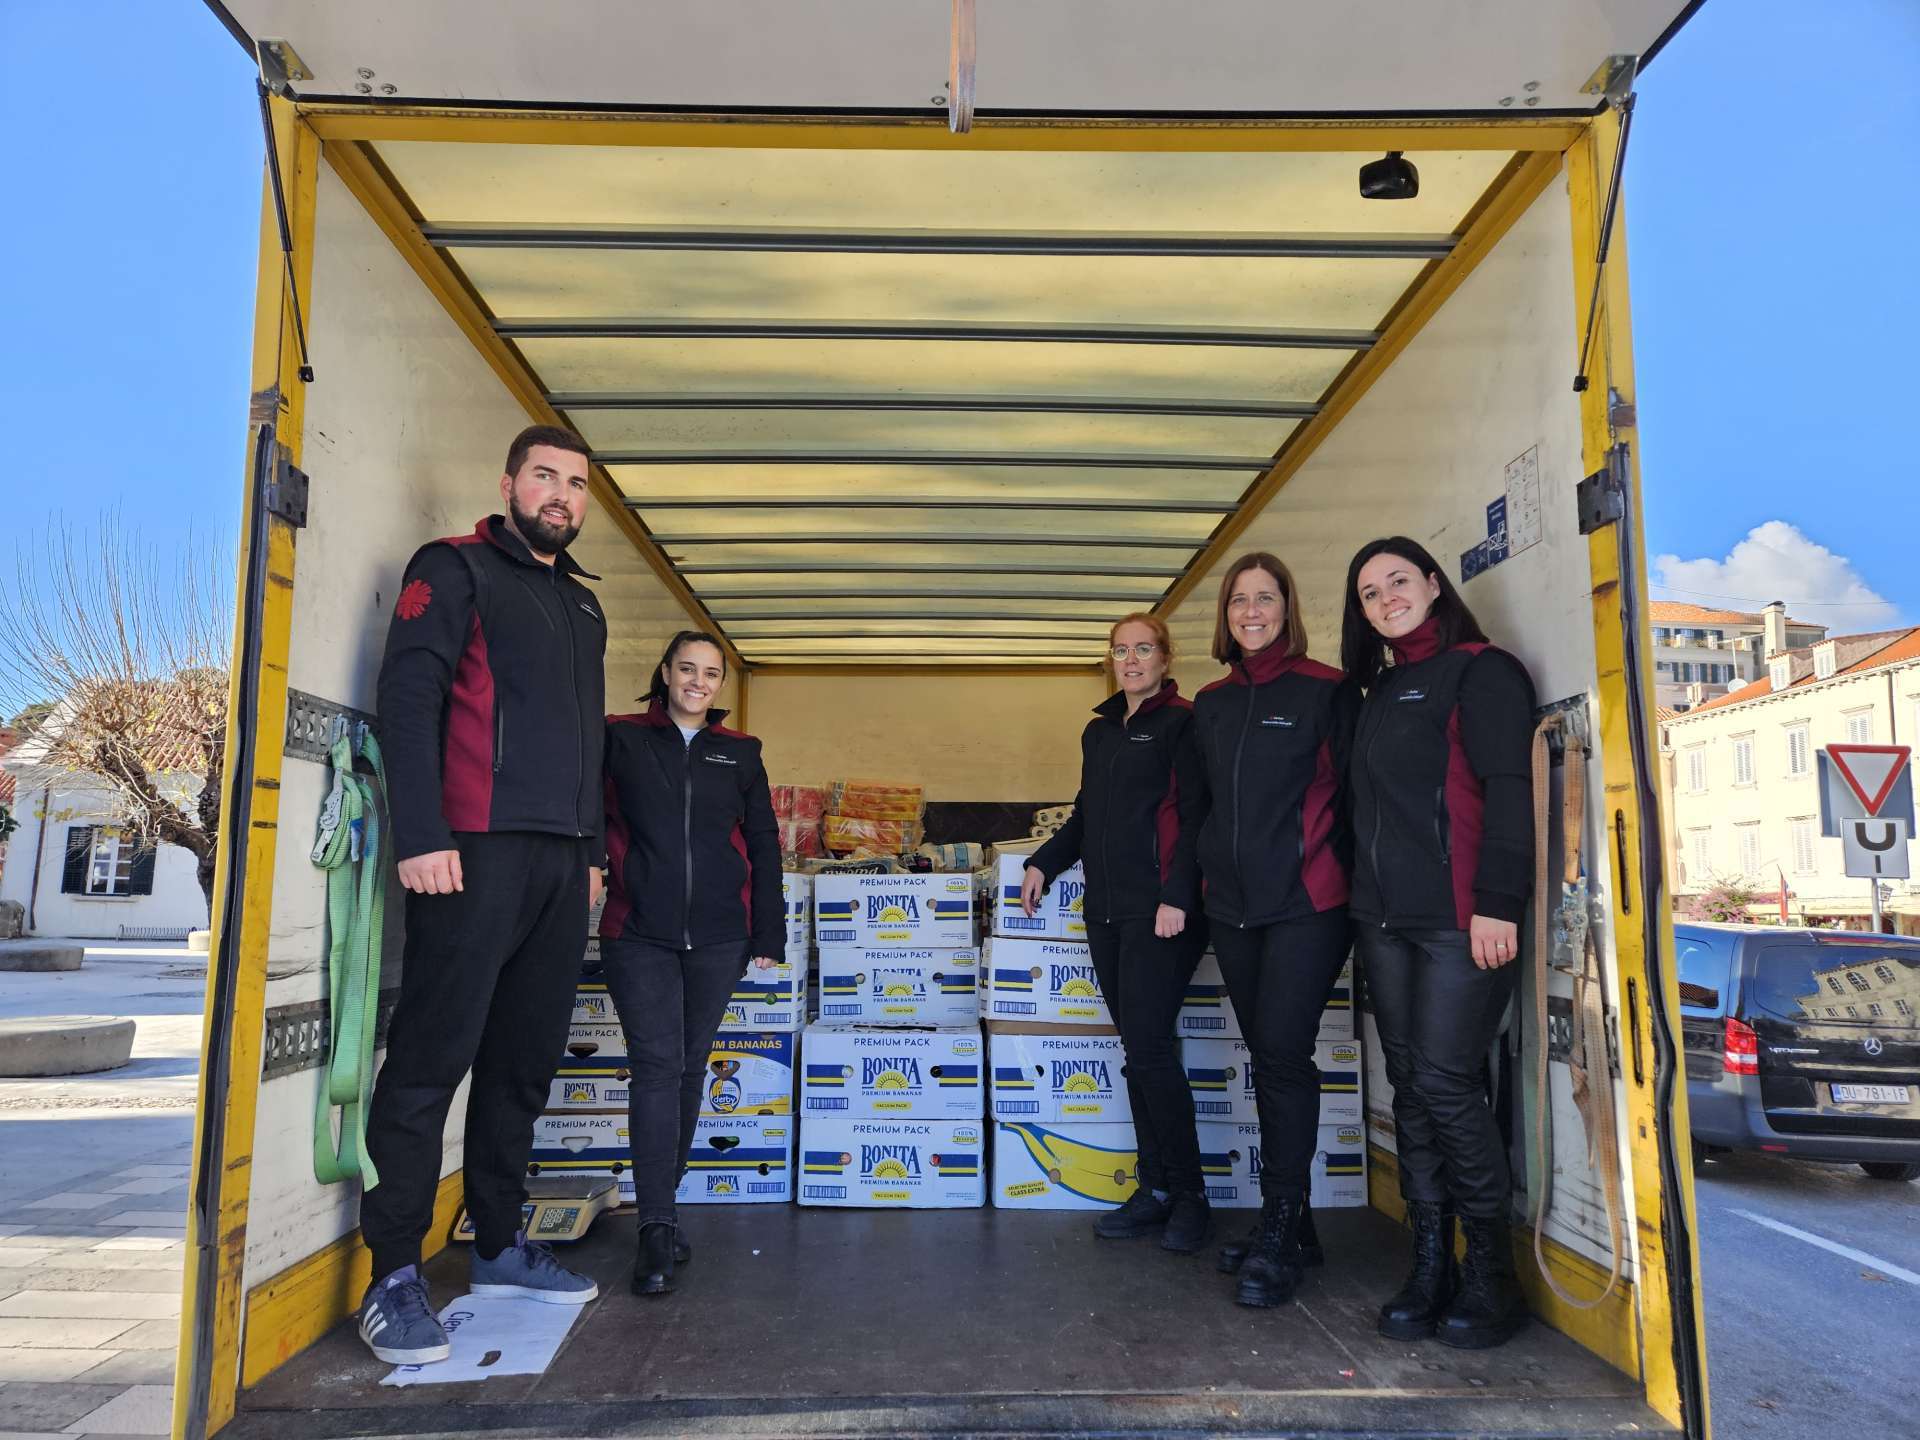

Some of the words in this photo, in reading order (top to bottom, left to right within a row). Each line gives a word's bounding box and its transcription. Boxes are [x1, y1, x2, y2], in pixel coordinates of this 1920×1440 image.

[860, 878, 901, 886] PREMIUM
[904, 878, 927, 886] PACK
[1058, 880, 1086, 908] BON
[867, 894, 920, 919] BONITA
[865, 951, 907, 959] PREMIUM
[910, 951, 933, 959] PACK
[1042, 945, 1088, 955] PREMIUM
[725, 1005, 746, 1020] NITA
[595, 1029, 618, 1037] PACK
[728, 1040, 783, 1049] BANANAS
[854, 1038, 901, 1047] PREMIUM
[904, 1038, 931, 1047] PACK
[1042, 1040, 1089, 1049] PREMIUM
[1093, 1040, 1119, 1049] PACK
[861, 1057, 922, 1085] BONITA
[1050, 1060, 1112, 1088] BONITA
[563, 1082, 597, 1099] BONITA
[1841, 1086, 1857, 1099] DU
[713, 1096, 736, 1104] derby
[545, 1120, 587, 1129] PREMIUM
[589, 1120, 613, 1128] PACK
[697, 1120, 733, 1128] REMIUM
[735, 1120, 759, 1128] PACK
[853, 1124, 901, 1134] PREMIUM
[904, 1125, 931, 1135] PACK
[860, 1144, 922, 1174] BONITA
[706, 1174, 740, 1191] BONITA
